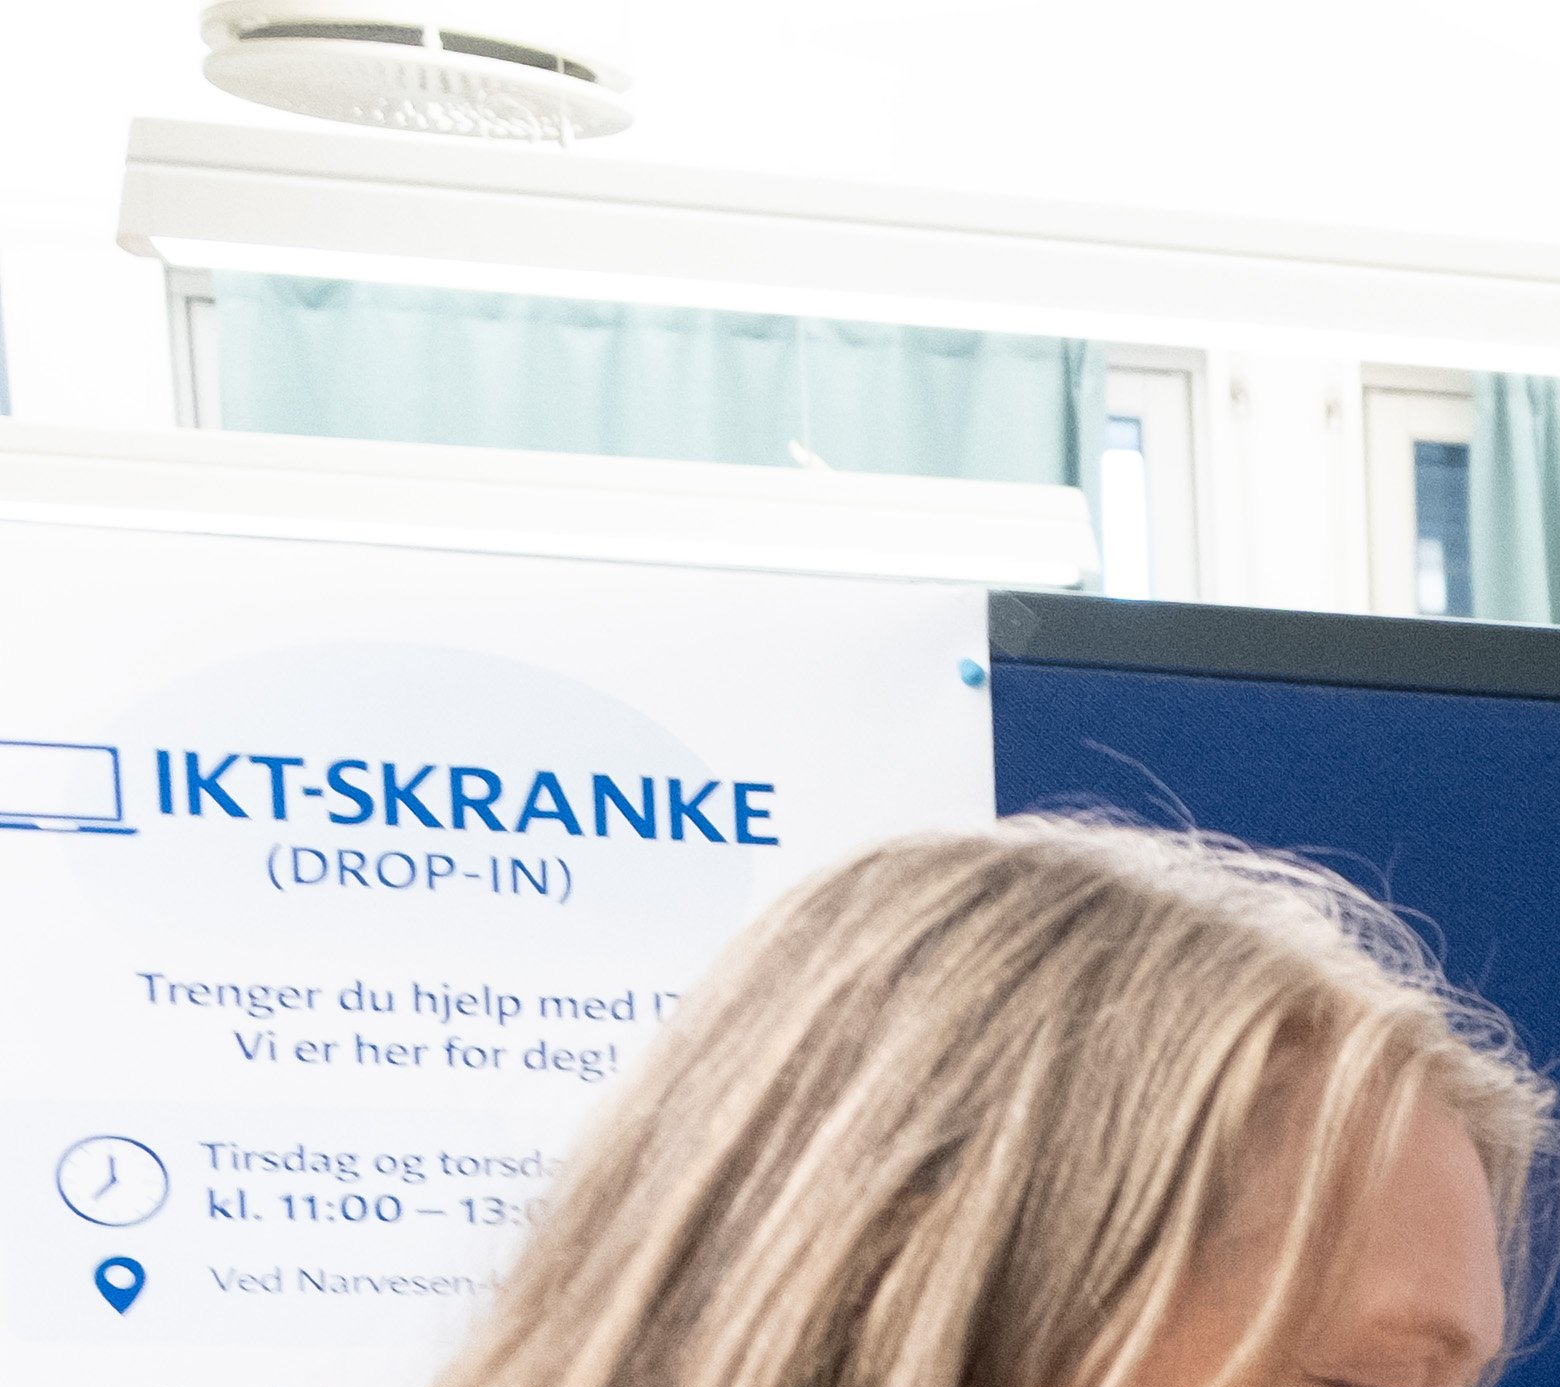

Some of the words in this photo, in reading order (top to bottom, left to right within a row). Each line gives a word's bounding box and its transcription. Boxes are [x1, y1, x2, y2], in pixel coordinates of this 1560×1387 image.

[154, 748, 782, 848] IKT-SKRANKE
[265, 844, 575, 905] (DROP-IN)
[136, 971, 323, 1016] Trenger
[339, 979, 397, 1017] du
[412, 981, 523, 1028] hjelp
[537, 989, 637, 1022] med
[232, 1030, 279, 1064] Vi
[293, 1036, 342, 1067] er
[354, 1035, 428, 1070] her
[443, 1035, 507, 1068] for
[521, 1039, 619, 1083] deg!
[199, 1141, 361, 1183] Tirsdag
[373, 1153, 427, 1185] og
[206, 1187, 263, 1222] kl.
[279, 1193, 404, 1224] 11:00
[208, 1266, 283, 1294] Ved
